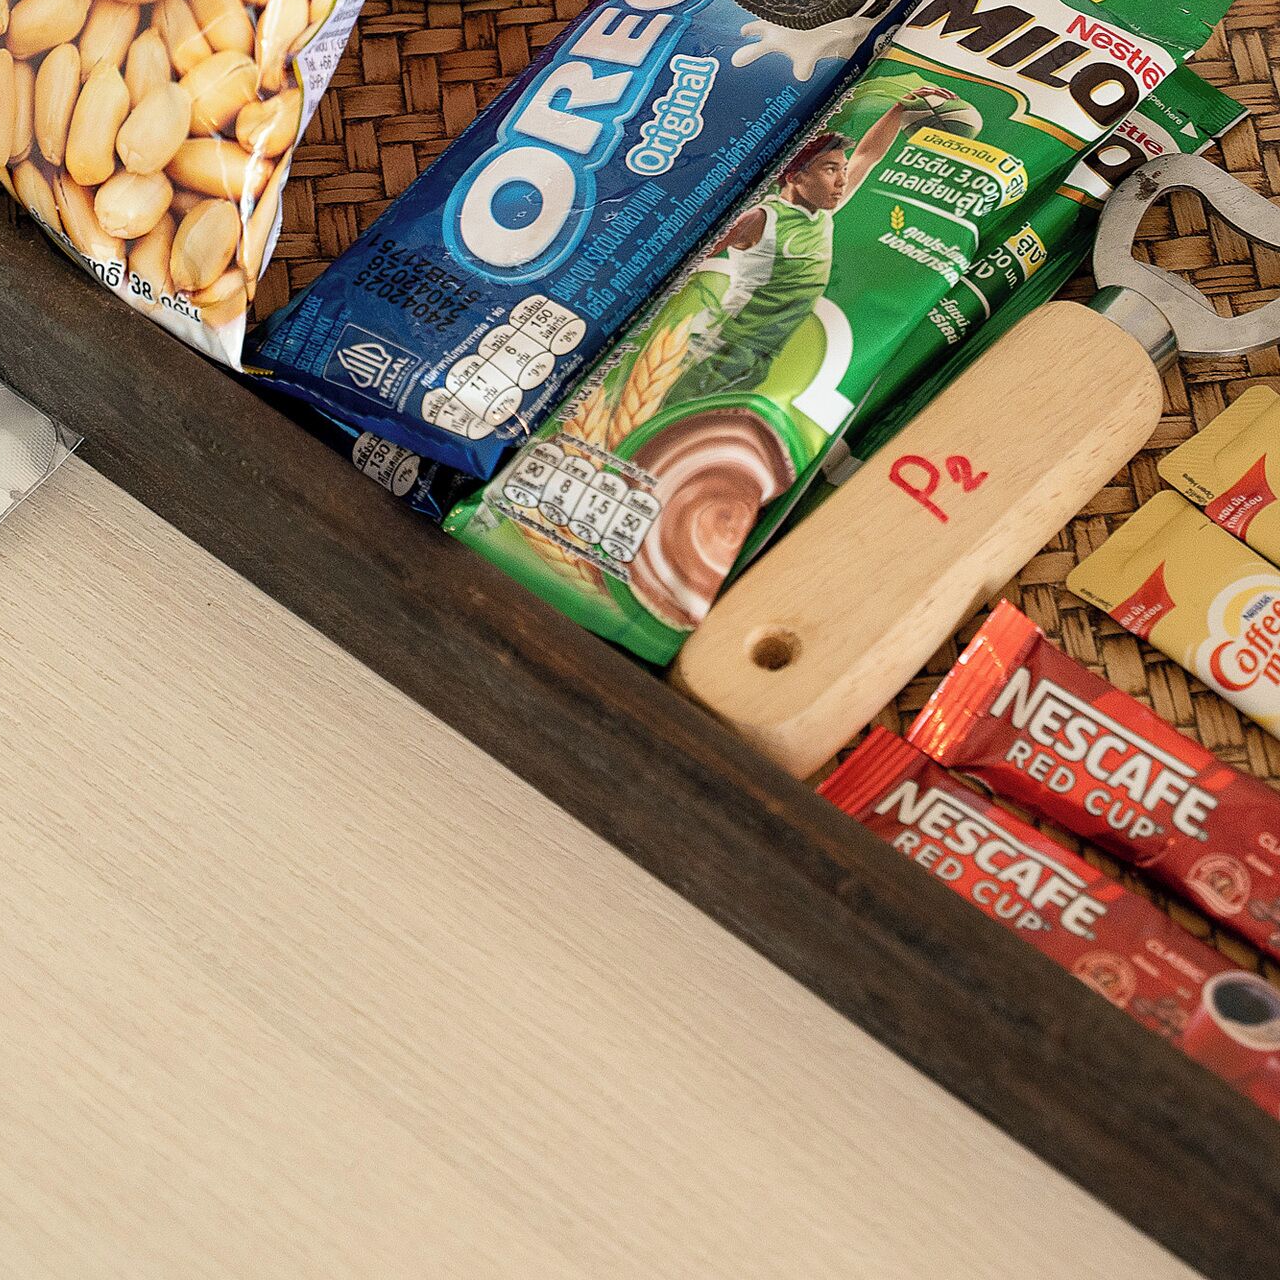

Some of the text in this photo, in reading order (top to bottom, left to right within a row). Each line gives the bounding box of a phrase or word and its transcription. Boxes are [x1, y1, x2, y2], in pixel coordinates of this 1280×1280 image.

[631, 55, 715, 172] Original
[895, 146, 956, 178] โปรตีน
[132, 273, 153, 301] 38
[352, 270, 456, 333] 24042025
[531, 309, 553, 328] 150
[505, 346, 516, 355] 6
[379, 357, 410, 399] HALAL
[471, 375, 487, 391] 11
[370, 444, 390, 469] 130
[560, 479, 571, 493] 8
[621, 514, 641, 532] 50
[1006, 739, 1156, 839] RED CUP
[891, 830, 1044, 932] RED CUP
